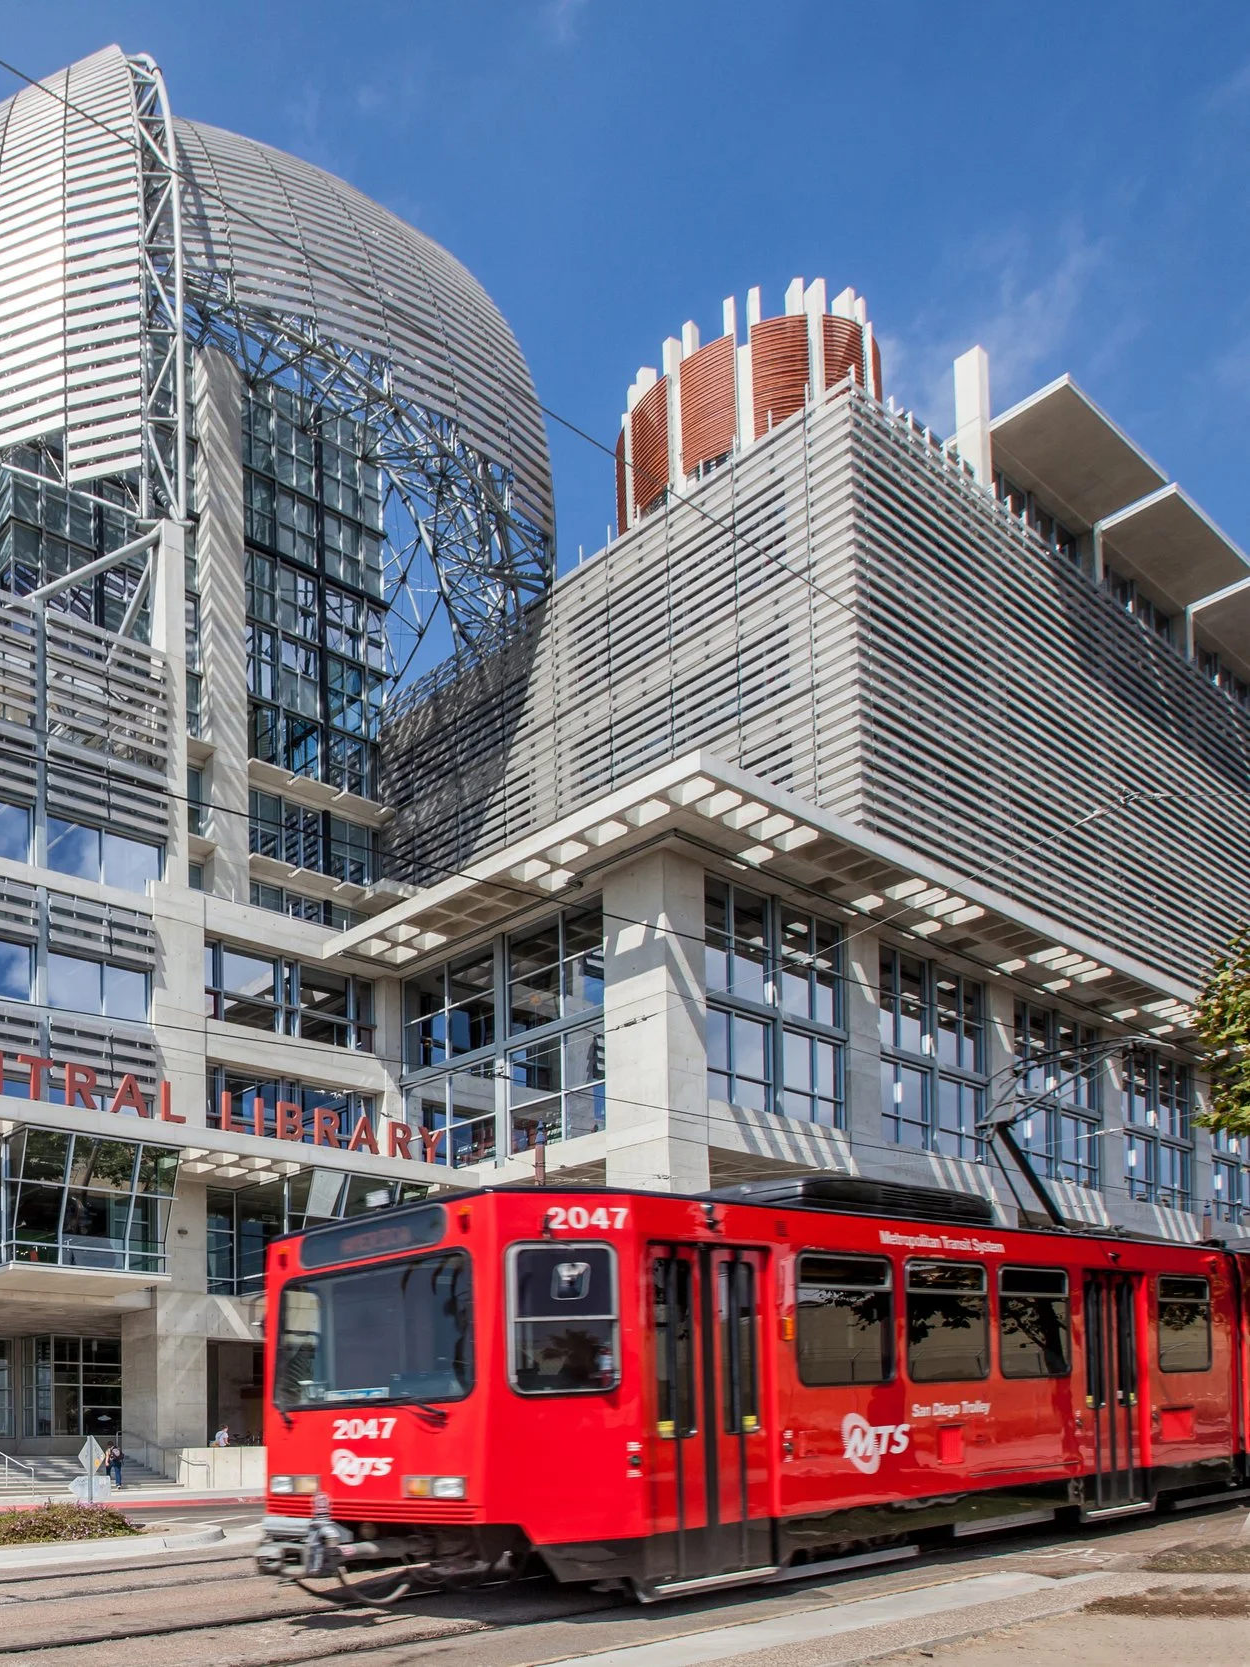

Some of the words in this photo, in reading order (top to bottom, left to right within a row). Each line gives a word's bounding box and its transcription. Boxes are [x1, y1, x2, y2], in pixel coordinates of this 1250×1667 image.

[221, 1091, 445, 1164] LIBRARY
[546, 1206, 629, 1230] 2047
[878, 1230, 942, 1249] Metropolitan
[940, 1235, 972, 1251] Transit
[971, 1238, 1006, 1255] System
[911, 1403, 931, 1418] San
[932, 1402, 960, 1418] Diego
[961, 1400, 991, 1415] Trolley
[332, 1417, 398, 1440] 2047
[842, 1423, 911, 1459] MTS
[331, 1455, 395, 1478] MTS
